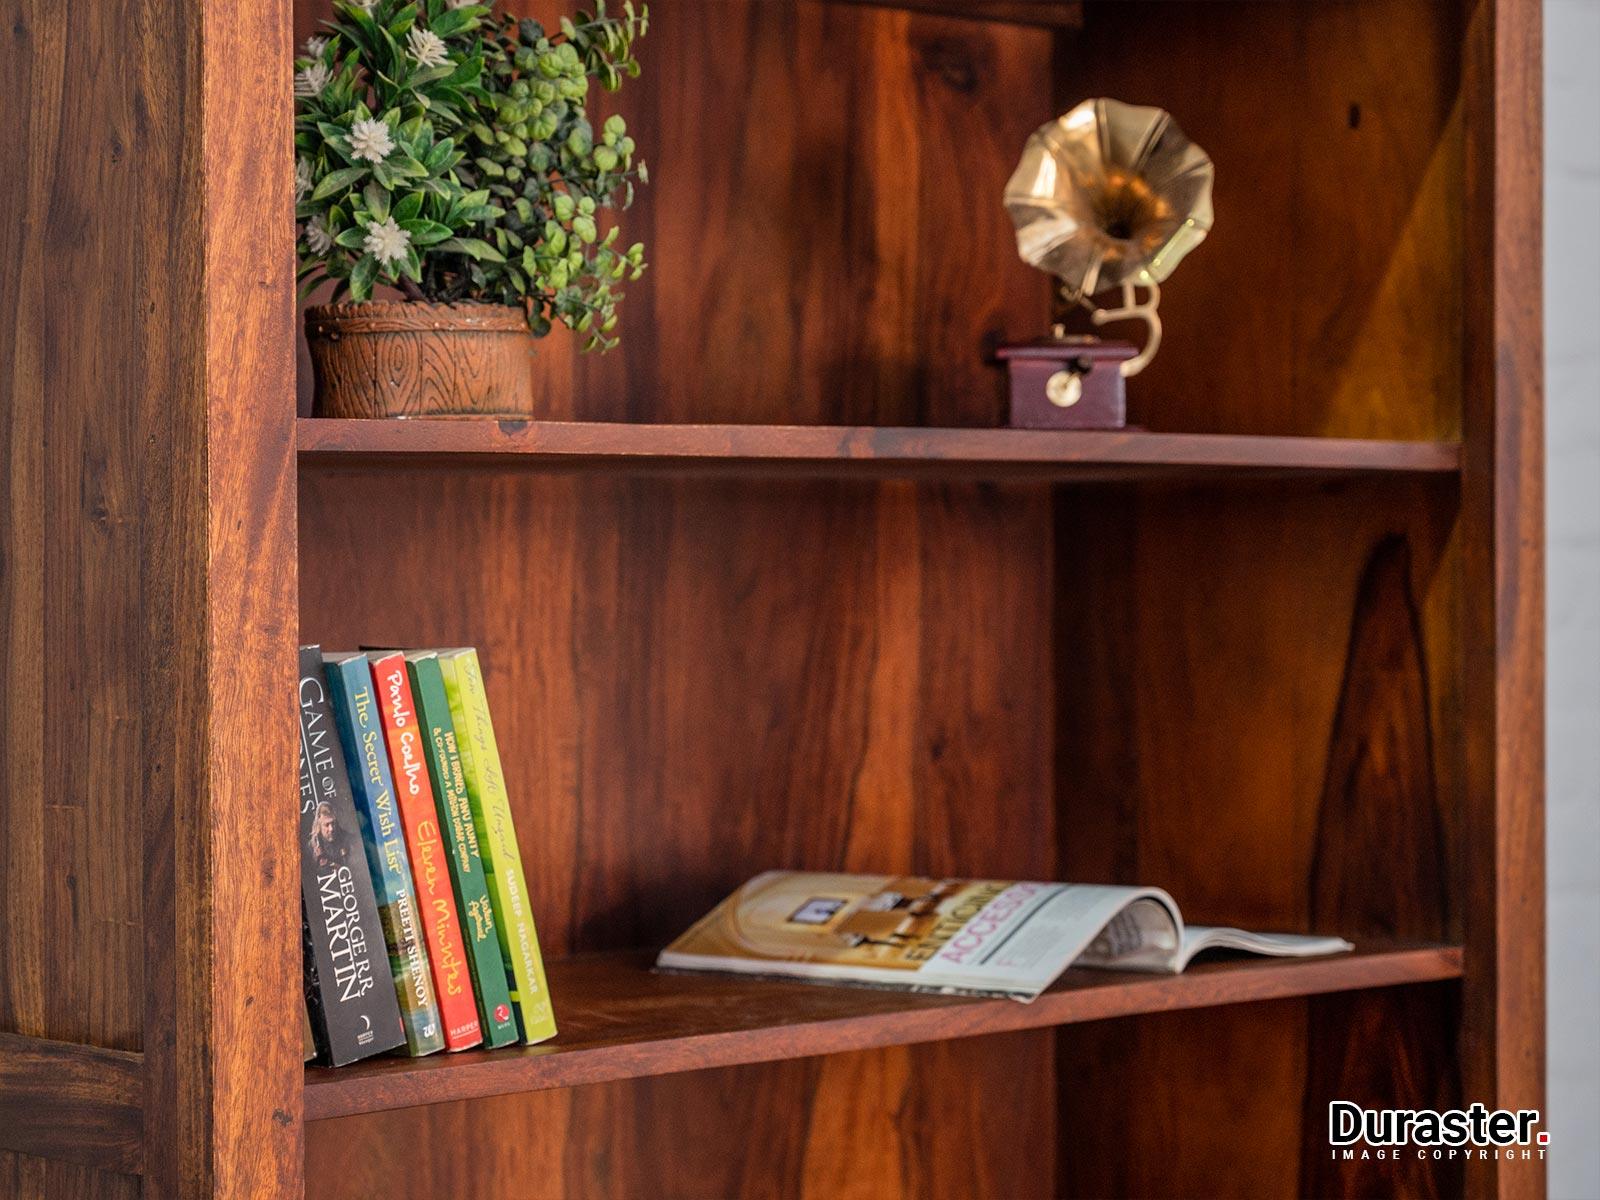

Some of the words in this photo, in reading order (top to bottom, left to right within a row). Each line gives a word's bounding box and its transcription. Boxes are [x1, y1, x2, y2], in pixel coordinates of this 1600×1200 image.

[354, 685, 371, 729] The
[299, 677, 335, 775] GAME
[321, 775, 338, 799] OF
[362, 731, 384, 787] Secret
[444, 731, 457, 754] HOW
[444, 780, 452, 789] A
[375, 788, 396, 836] Wish
[458, 797, 472, 821] ANU
[383, 838, 402, 875] List
[463, 822, 480, 858] AUNTY
[338, 866, 367, 957] GEORGE
[416, 820, 438, 896] Eleven
[432, 899, 463, 996] Minutes
[506, 868, 523, 918] SUDEEP
[517, 921, 538, 994] NAGARKAR
[317, 869, 361, 1003] MARTIN
[396, 888, 412, 941] PREETI
[406, 940, 429, 1007] SHENOY
[450, 1021, 479, 1036] HARPER
